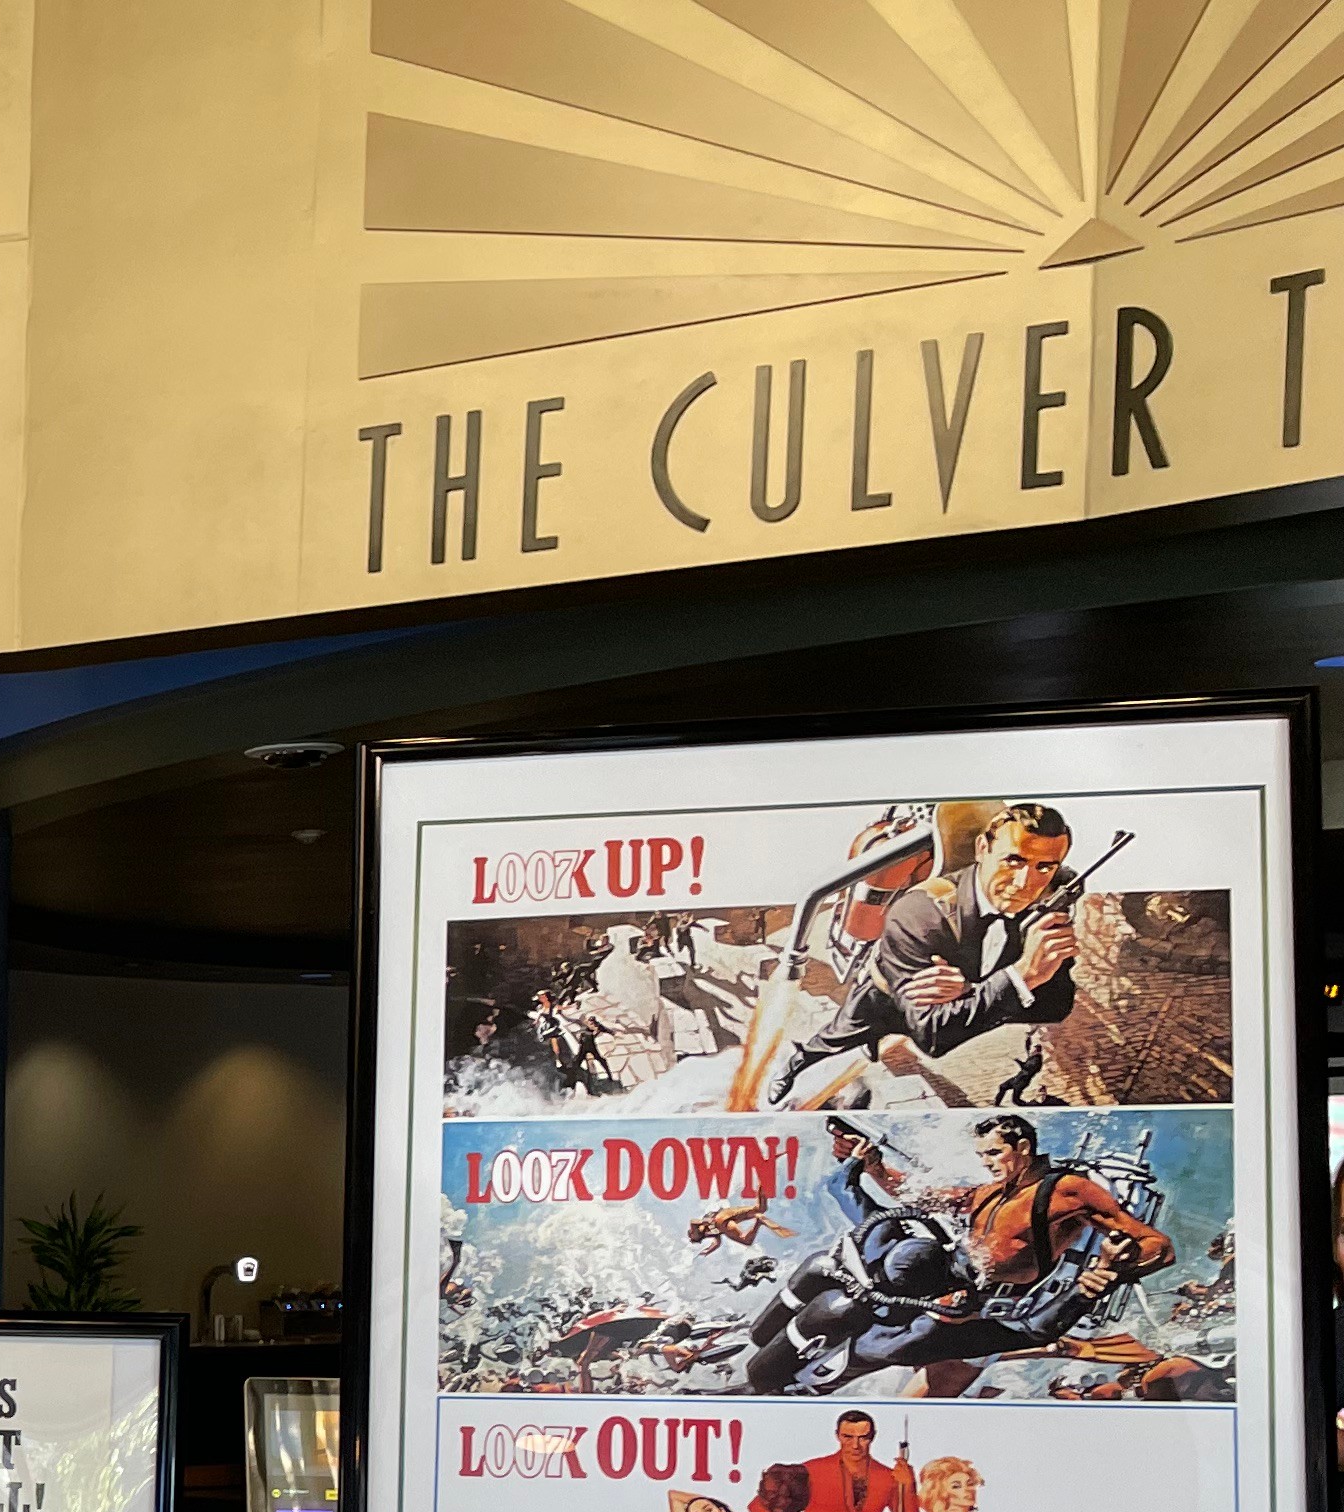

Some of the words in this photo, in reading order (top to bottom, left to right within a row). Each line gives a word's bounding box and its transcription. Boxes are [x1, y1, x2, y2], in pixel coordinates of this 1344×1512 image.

[358, 397, 565, 573] THE
[651, 306, 1175, 534] CULVER
[604, 835, 705, 898] UP!
[602, 1136, 800, 1201] DOWN!
[596, 1415, 744, 1484] OUT!
